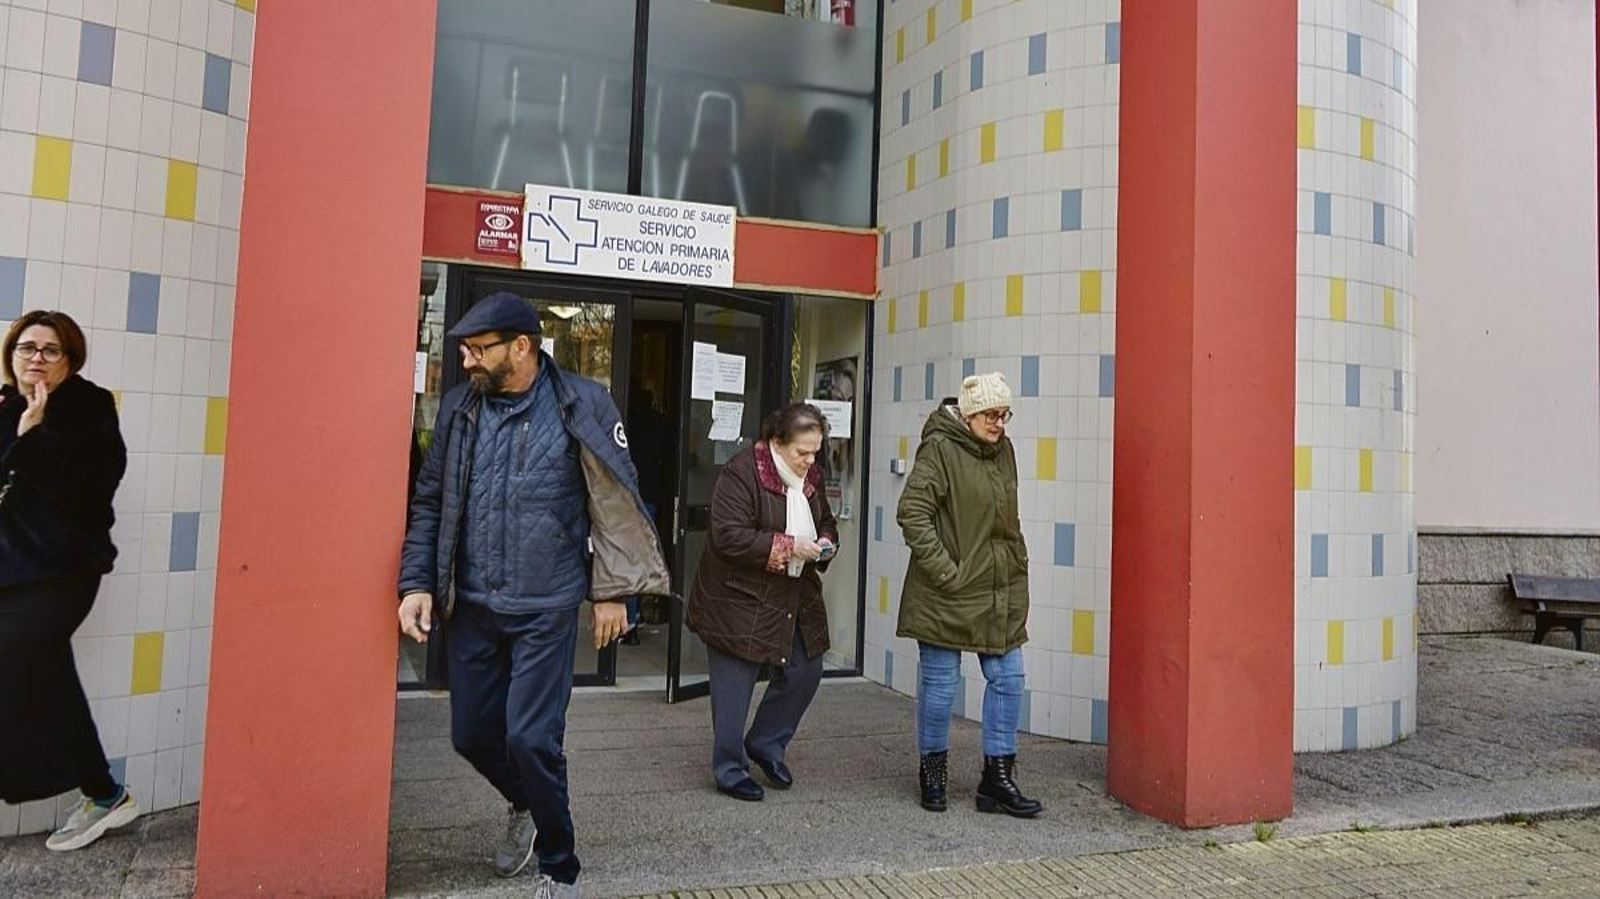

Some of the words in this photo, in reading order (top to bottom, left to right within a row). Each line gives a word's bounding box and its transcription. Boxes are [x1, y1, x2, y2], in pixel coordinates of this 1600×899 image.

[587, 199, 633, 213] SERVICIO
[638, 204, 678, 218] GALEGO
[683, 208, 696, 220] DE
[700, 211, 731, 225] SAUDE
[639, 221, 696, 239] SERVICIO
[601, 237, 664, 255] ATENCION
[670, 244, 730, 262] PRIMARIA
[618, 257, 635, 271] DE
[642, 260, 713, 279] LAVADORES
